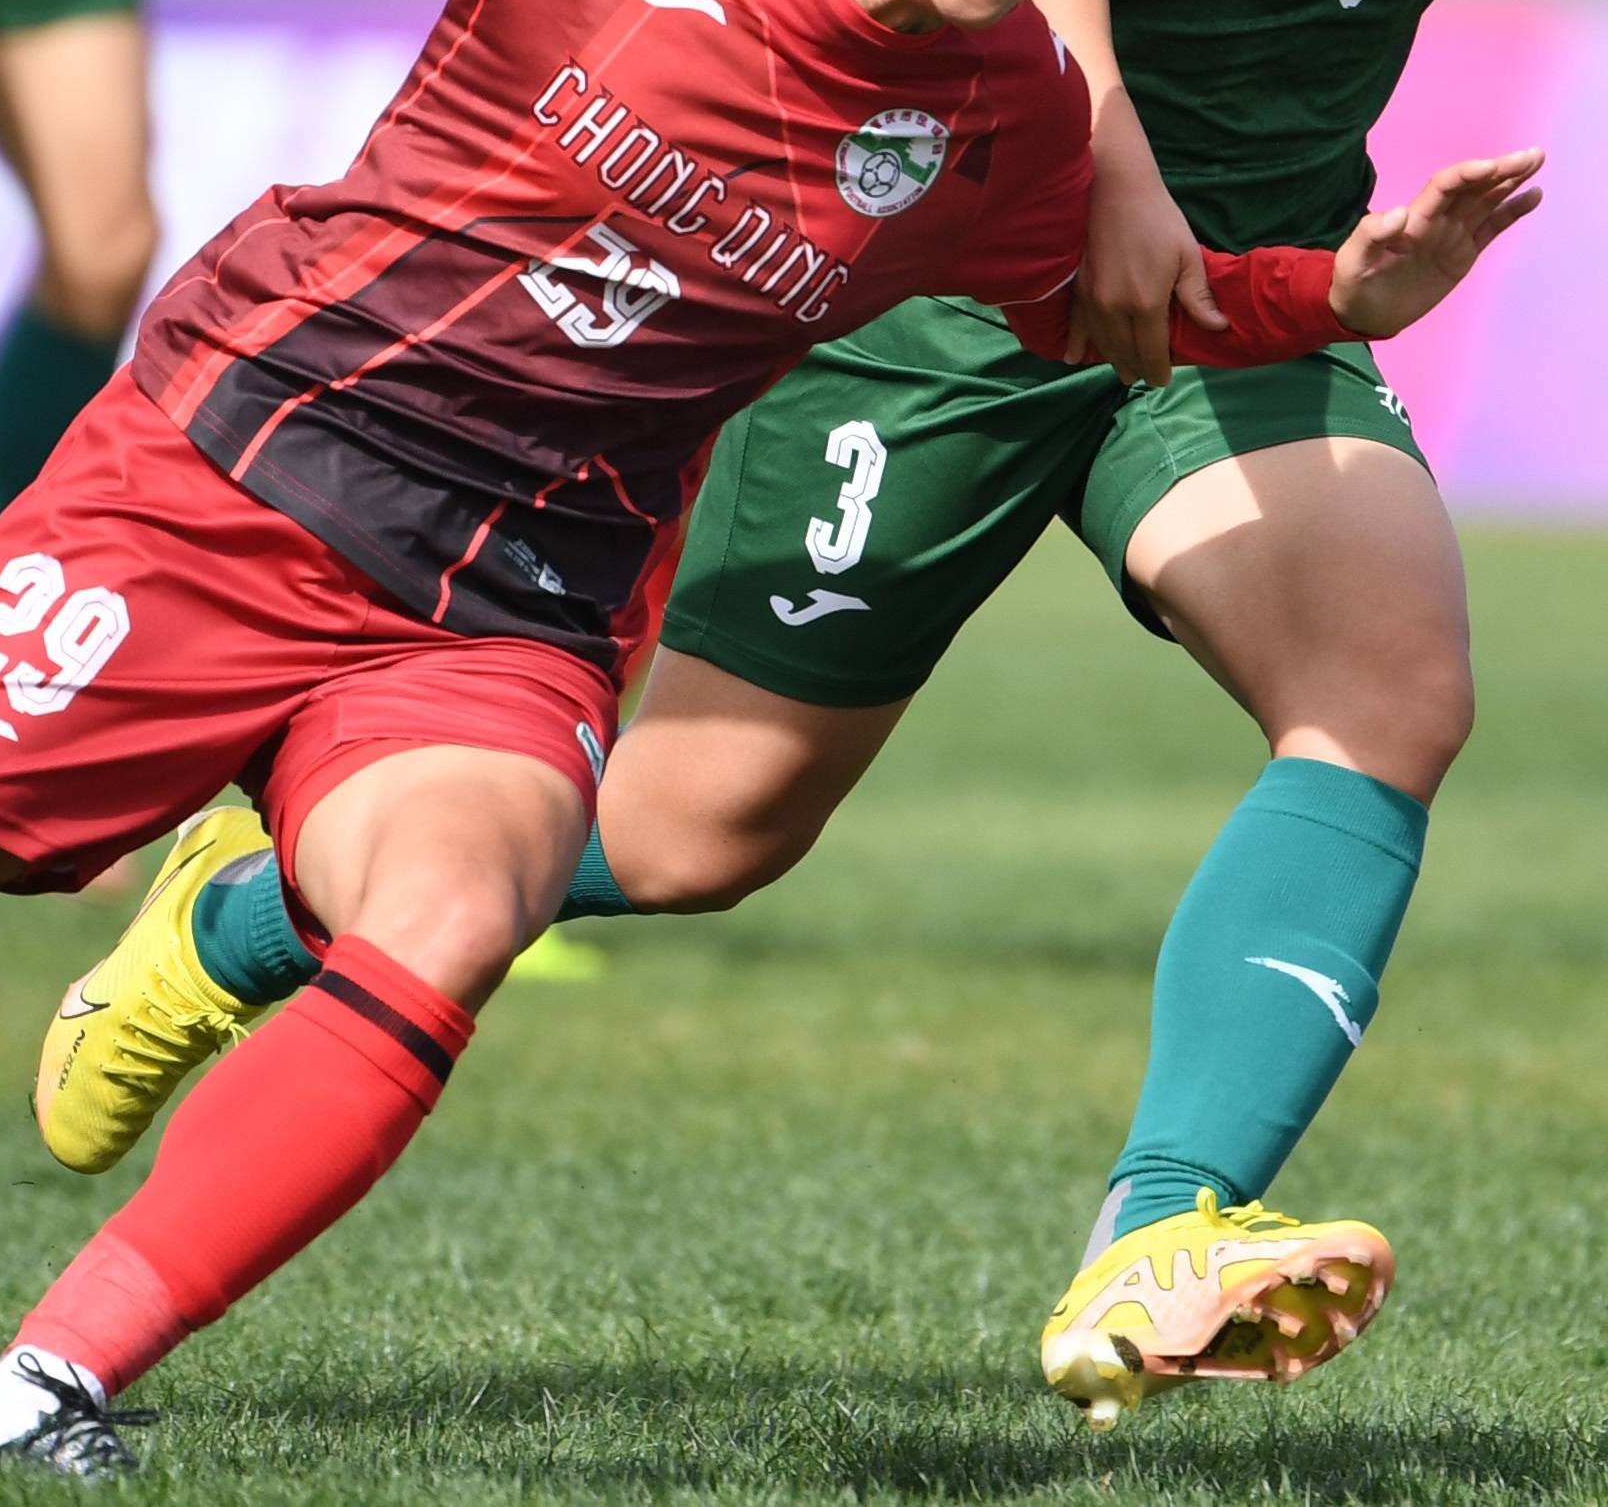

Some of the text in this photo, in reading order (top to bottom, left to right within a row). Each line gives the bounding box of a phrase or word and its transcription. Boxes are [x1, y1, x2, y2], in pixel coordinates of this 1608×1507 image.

[531, 58, 849, 323] CHONG QING
[516, 222, 682, 349] 29
[804, 420, 888, 575] 3
